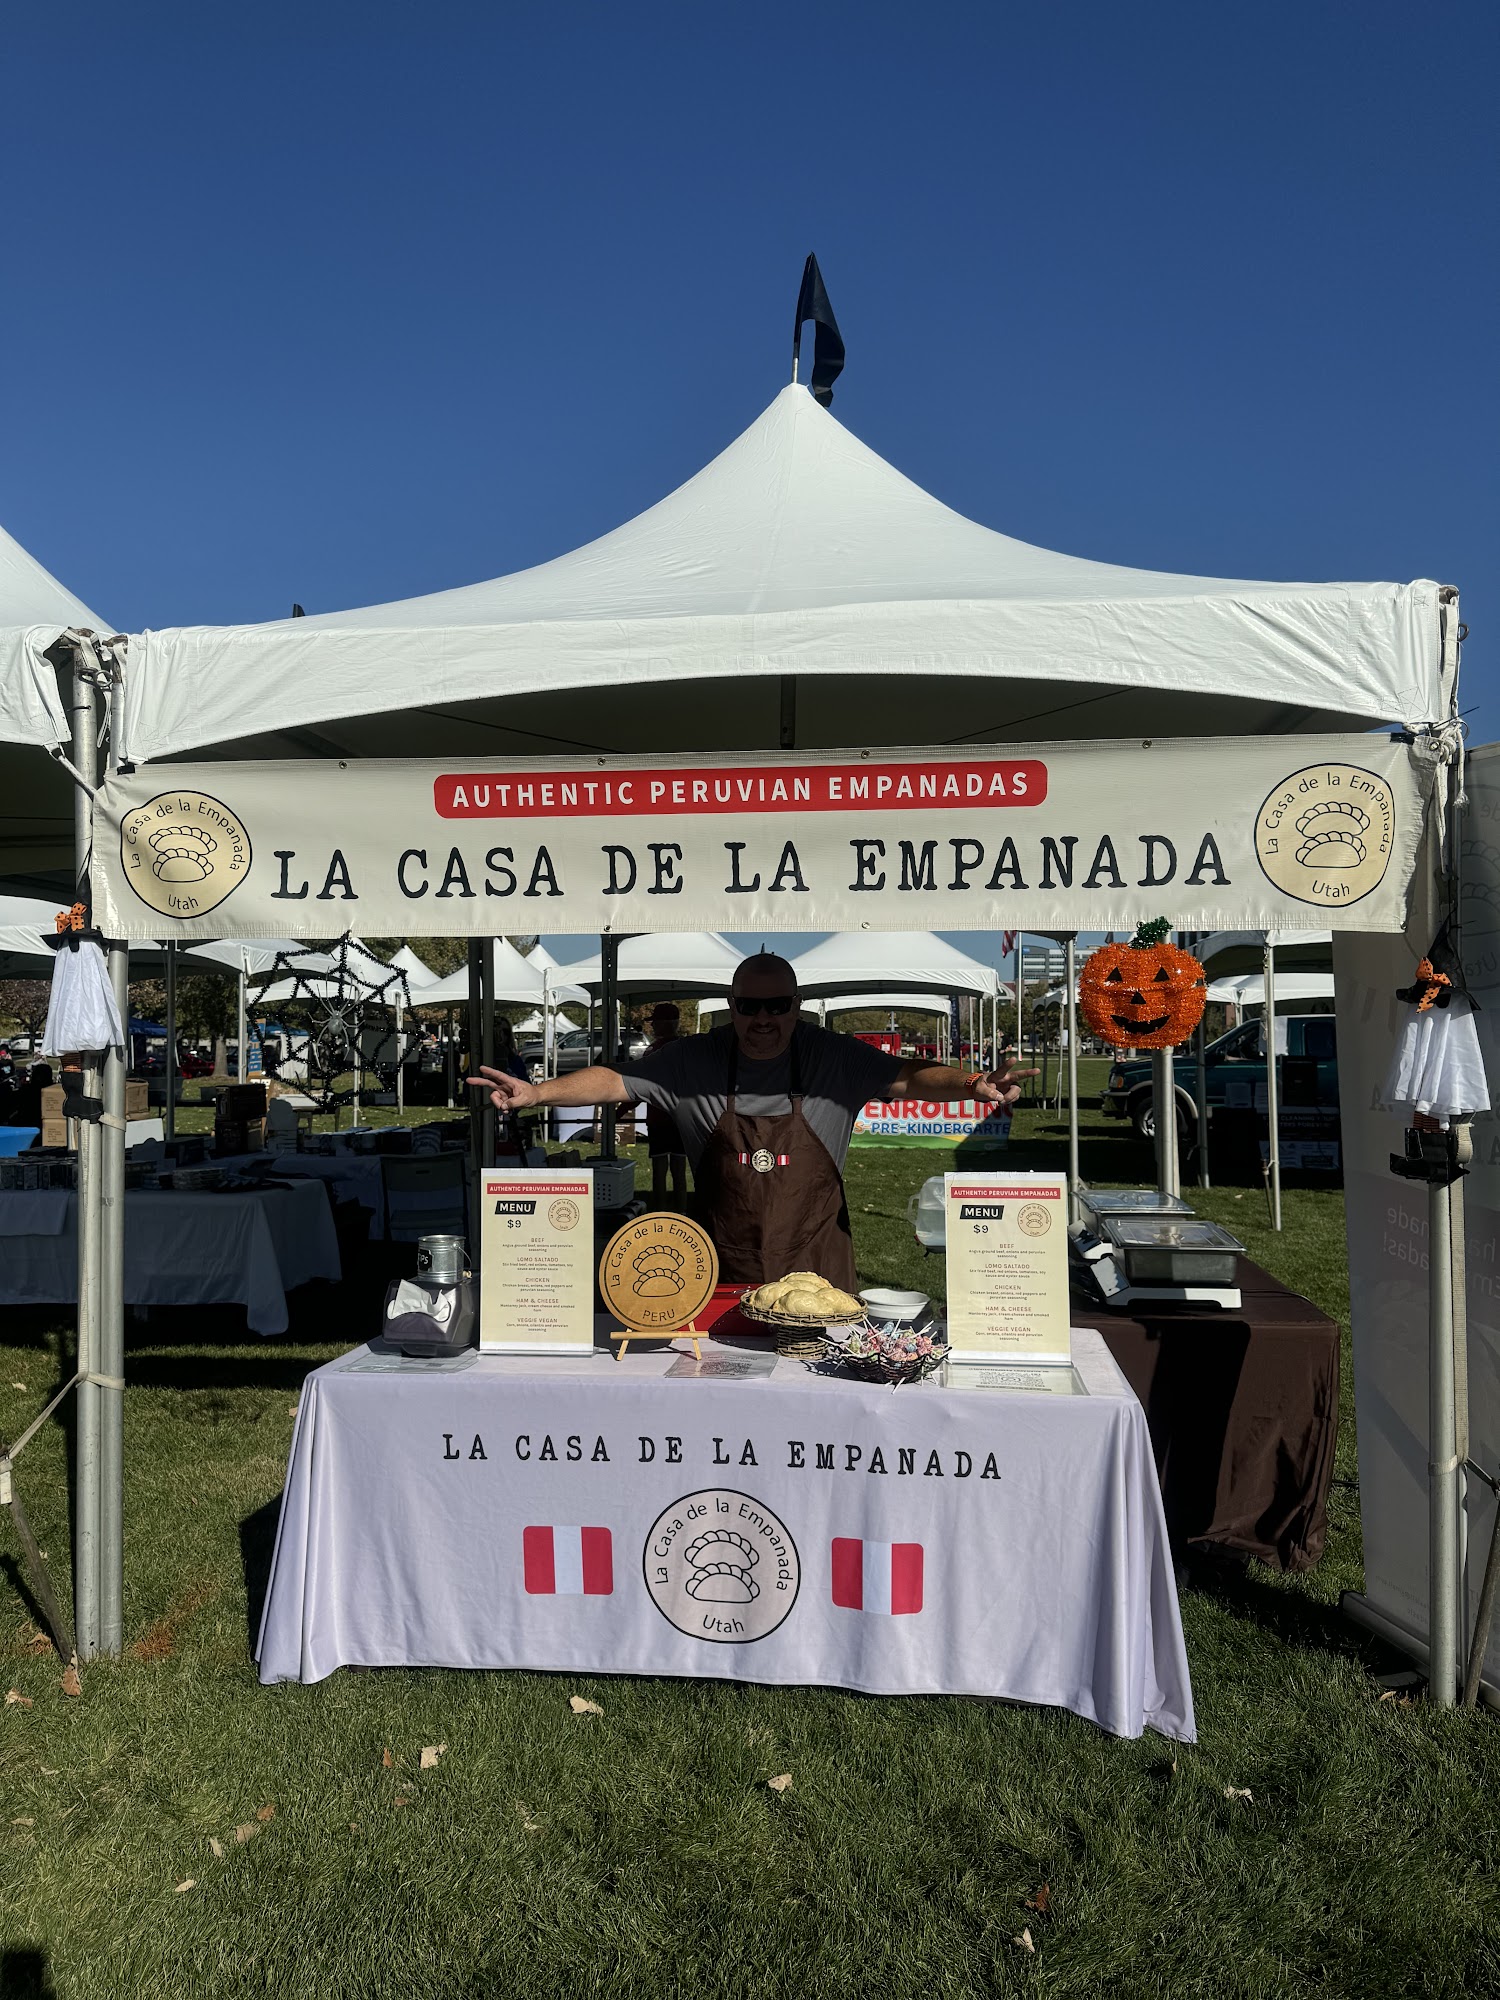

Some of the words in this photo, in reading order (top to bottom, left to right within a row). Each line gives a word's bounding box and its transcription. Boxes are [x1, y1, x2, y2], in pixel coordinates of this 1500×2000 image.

[1298, 778, 1319, 793] de
[1327, 772, 1341, 786] la
[453, 782, 633, 807] AUTHENTIC
[651, 778, 809, 803] PERUVIAN
[830, 772, 1027, 799] EMPANADAS
[156, 804, 174, 818] de
[178, 798, 191, 812] la
[1265, 793, 1296, 829] Casa
[1349, 774, 1391, 853] Empanada
[126, 814, 151, 845] Casa
[198, 801, 246, 871] Empanada
[1265, 838, 1279, 855] La
[130, 853, 142, 869] La
[271, 849, 359, 899] LA
[398, 846, 564, 898] CASA
[601, 843, 683, 895] DE
[724, 841, 810, 893] LA
[849, 833, 1231, 891] EMPANADA
[1312, 880, 1350, 898] Utah
[168, 894, 199, 910] Utah
[499, 1203, 531, 1212] MENU
[965, 1208, 999, 1217] MENU
[507, 1219, 522, 1229] $9
[653, 1223, 663, 1233] la
[973, 1224, 989, 1234] $9
[634, 1227, 649, 1240] de
[611, 1238, 632, 1268] Casa
[669, 1223, 707, 1280] Empanada
[610, 1274, 621, 1288] La
[642, 1309, 675, 1322] PERU
[443, 1434, 487, 1459] LA
[516, 1435, 610, 1461] CASA
[638, 1437, 682, 1463] DE
[713, 1438, 758, 1465] LA
[788, 1441, 1001, 1479] EMPANADA
[687, 1504, 708, 1520] de
[716, 1498, 730, 1513] la
[655, 1519, 684, 1557] Casa
[738, 1503, 794, 1591] Empanada
[655, 1567, 669, 1585] La
[703, 1614, 744, 1633] Utah
